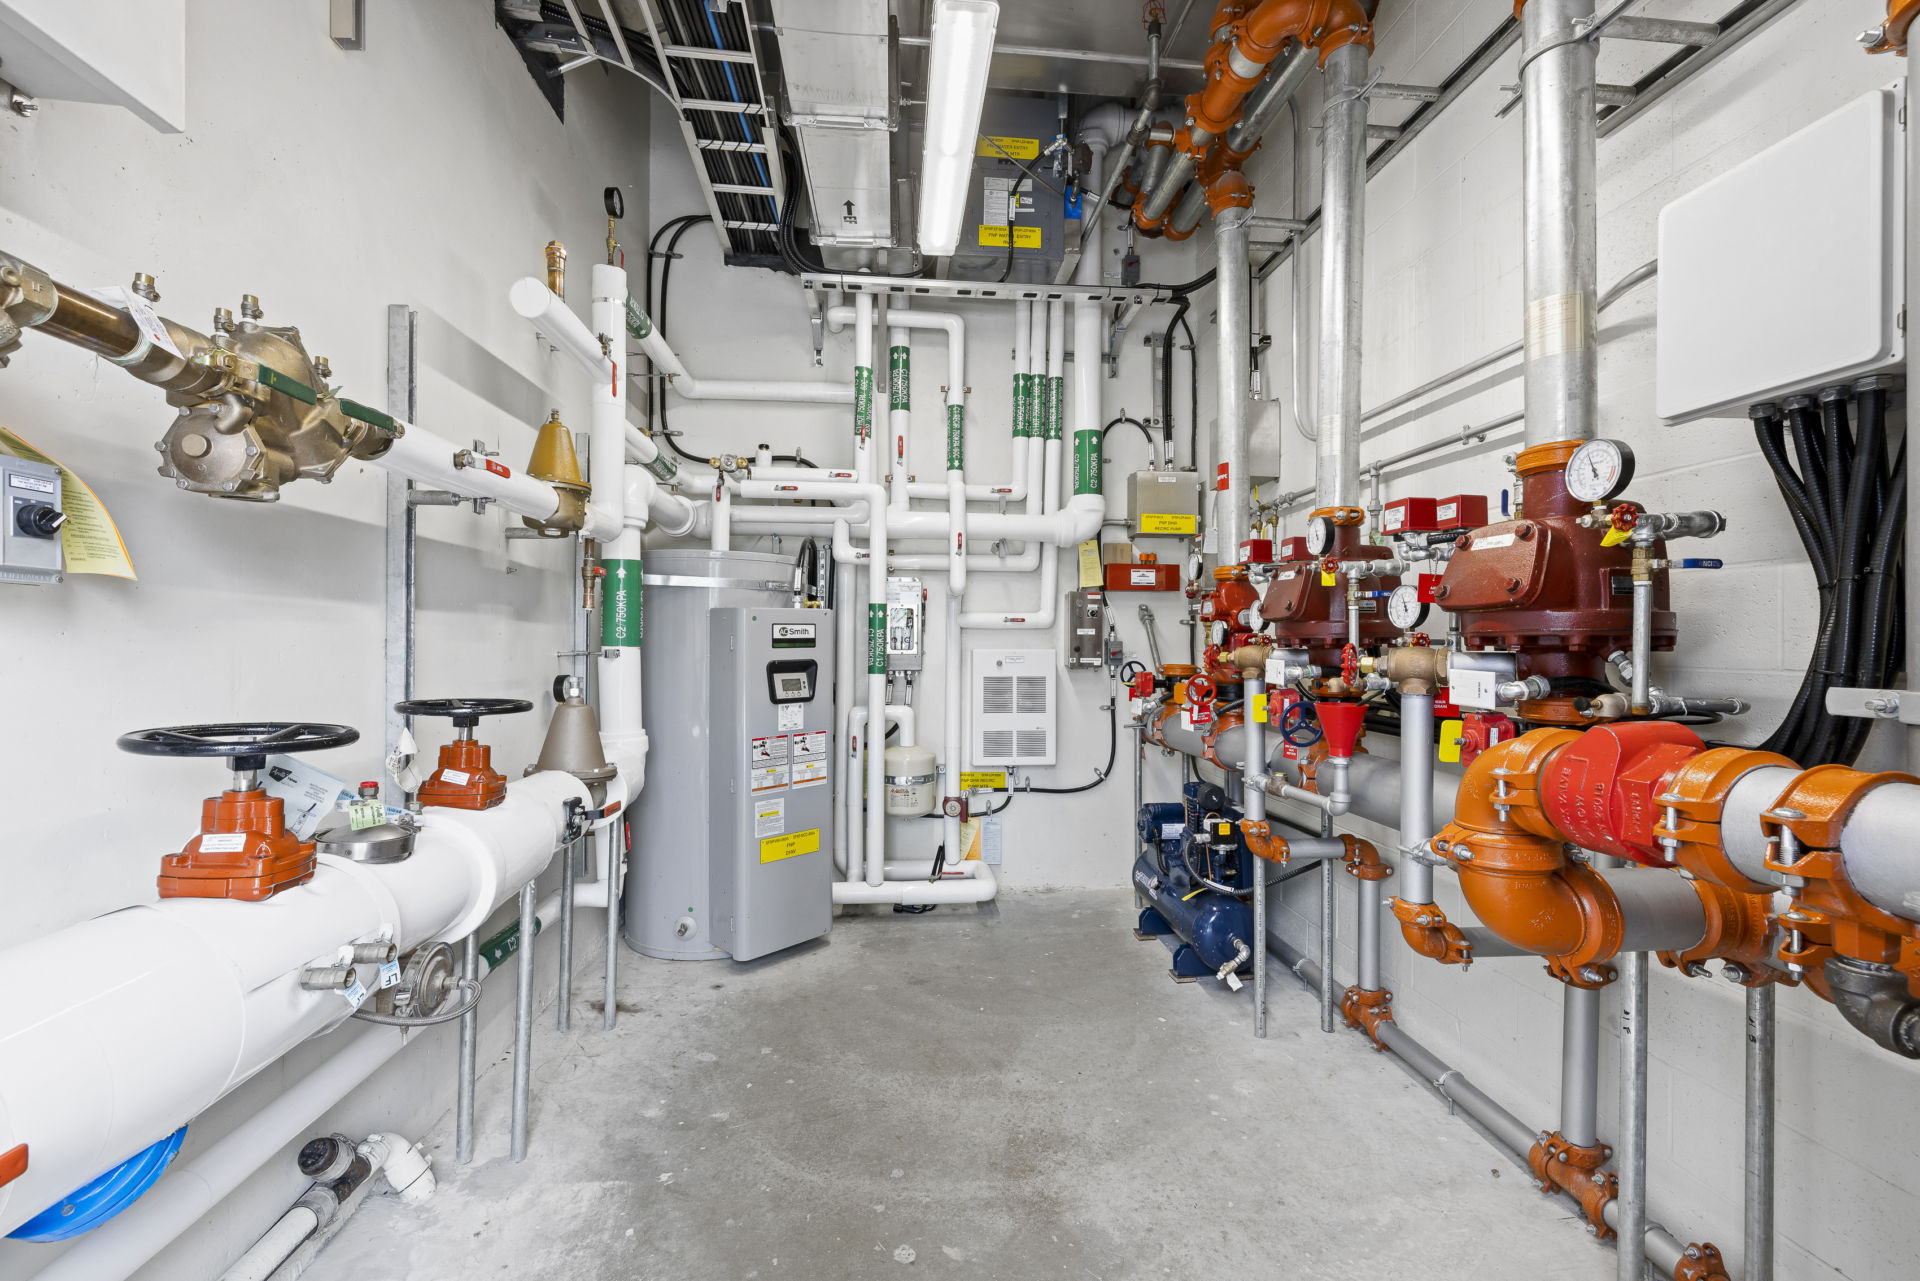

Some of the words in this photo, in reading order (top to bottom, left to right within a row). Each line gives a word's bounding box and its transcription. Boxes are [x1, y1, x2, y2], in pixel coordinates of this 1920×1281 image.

[1090, 452, 1098, 489] C2/750KPA
[615, 589, 627, 639] C2/750KPA
[789, 628, 810, 636] Smith
[876, 628, 884, 667] C1/750KPA
[384, 973, 399, 988] LF
